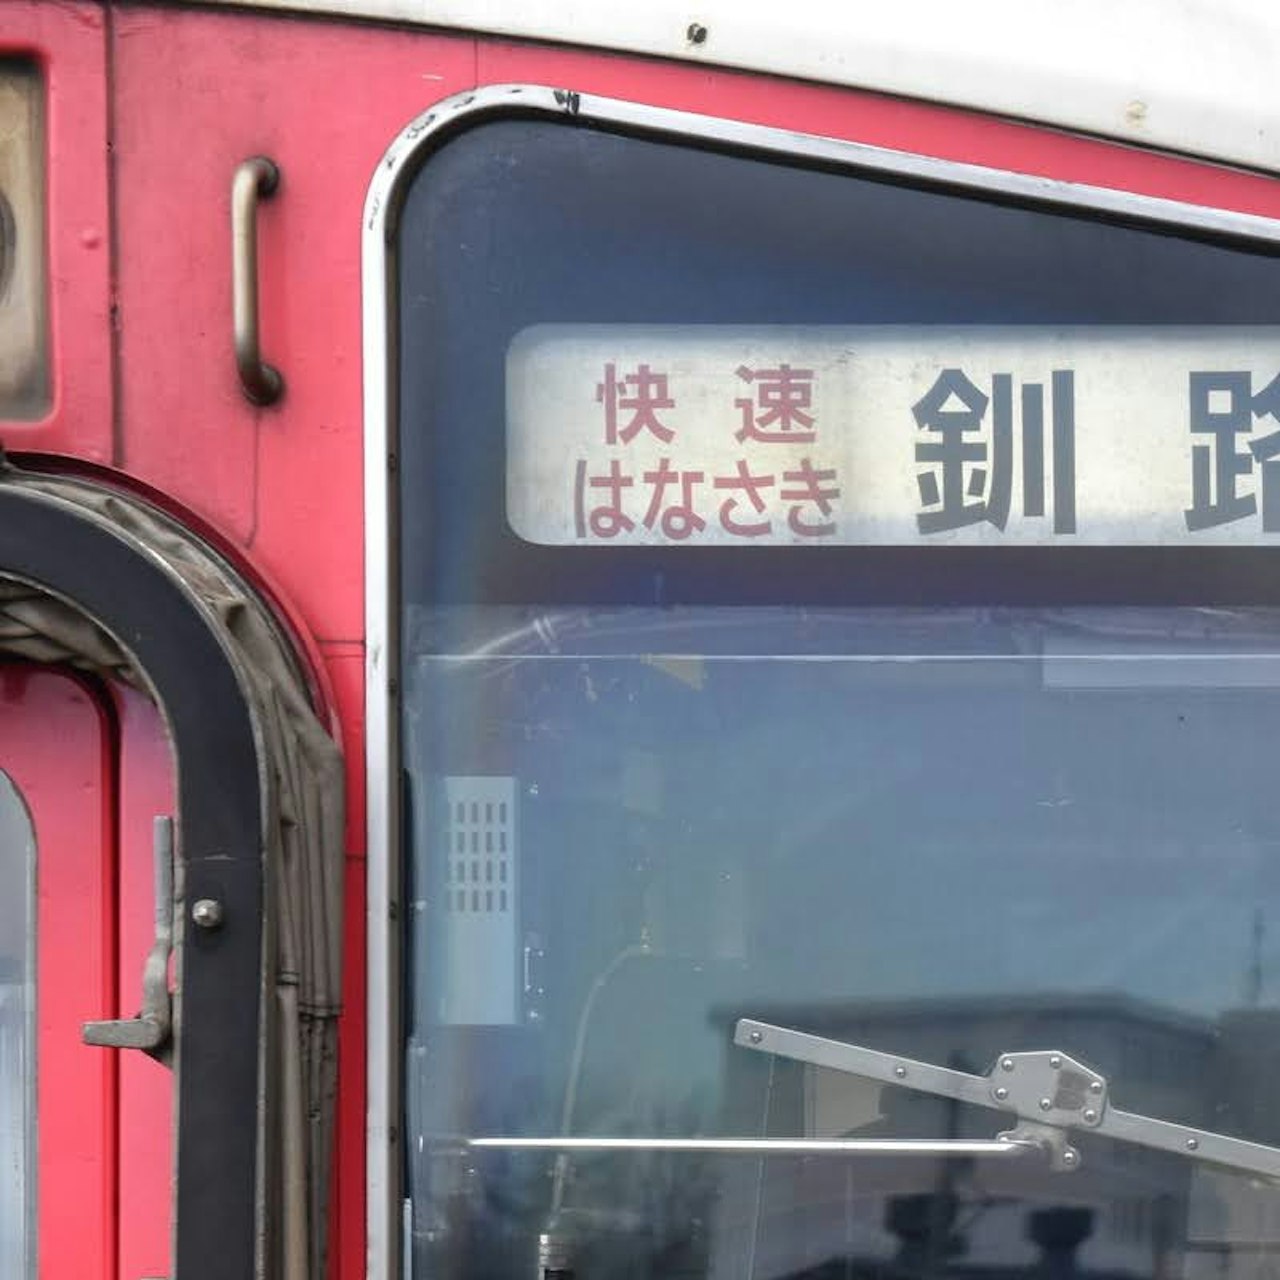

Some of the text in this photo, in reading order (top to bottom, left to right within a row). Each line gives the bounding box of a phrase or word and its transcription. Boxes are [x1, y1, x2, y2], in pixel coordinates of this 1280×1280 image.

[596, 363, 816, 445] 快速
[574, 457, 841, 540] はなさき
